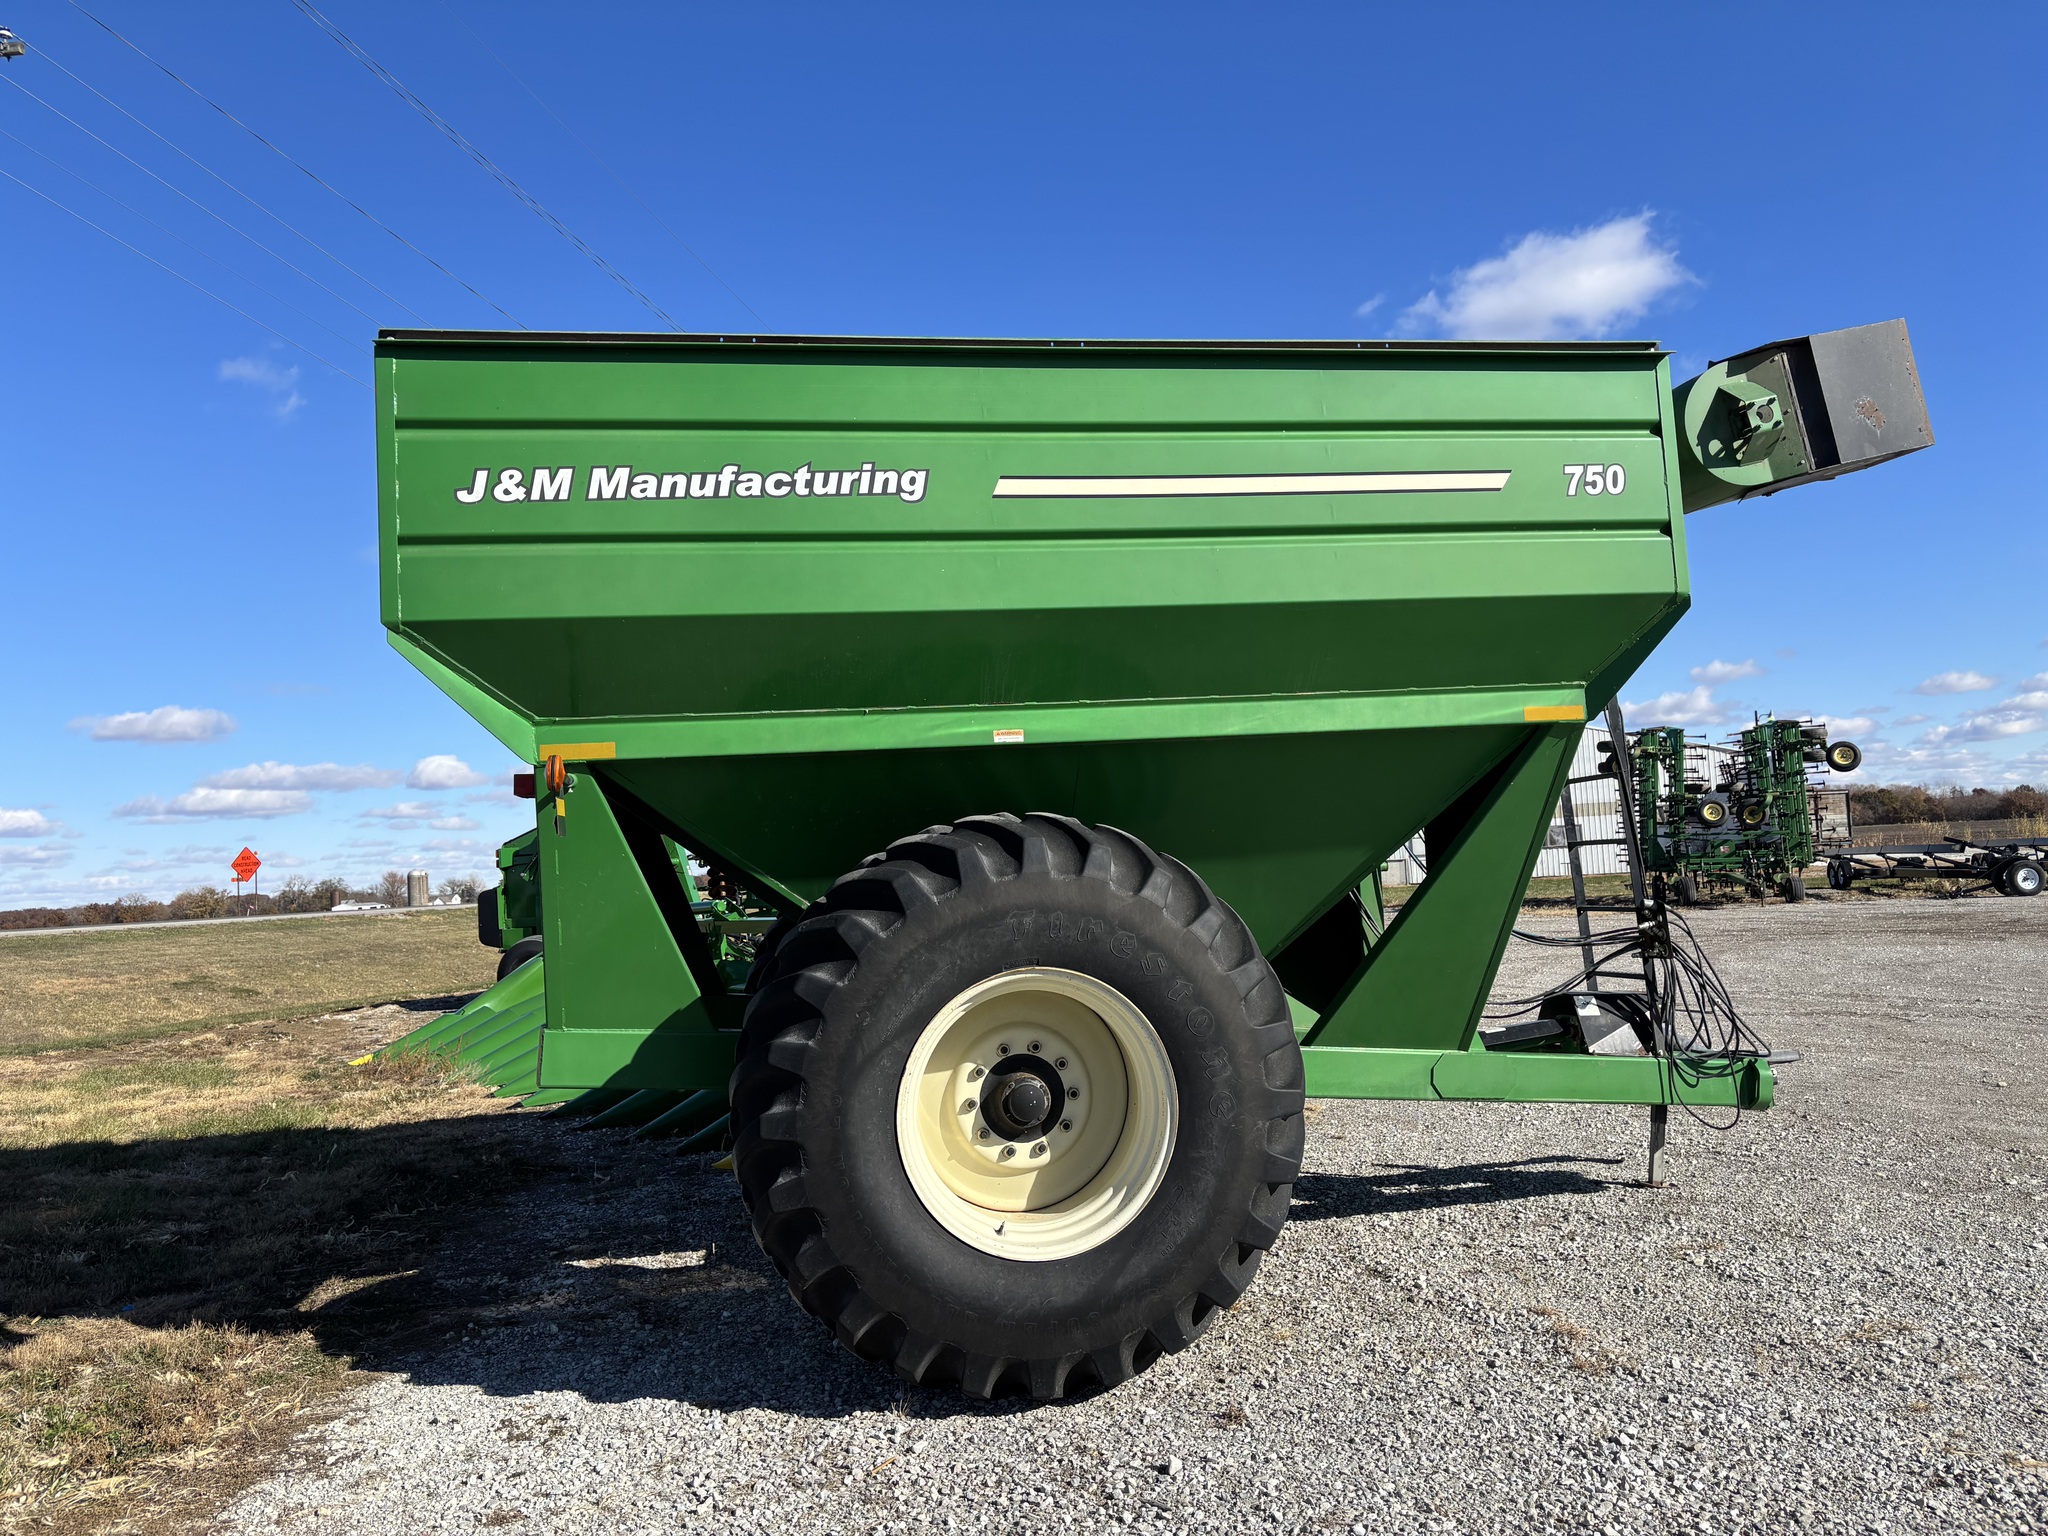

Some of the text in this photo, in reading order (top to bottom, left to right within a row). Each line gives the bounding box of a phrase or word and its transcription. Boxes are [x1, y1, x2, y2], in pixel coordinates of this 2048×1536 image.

[585, 460, 929, 503] Manufacturing
[1563, 463, 1626, 497] 750
[1006, 909, 1237, 1119] Firestone
